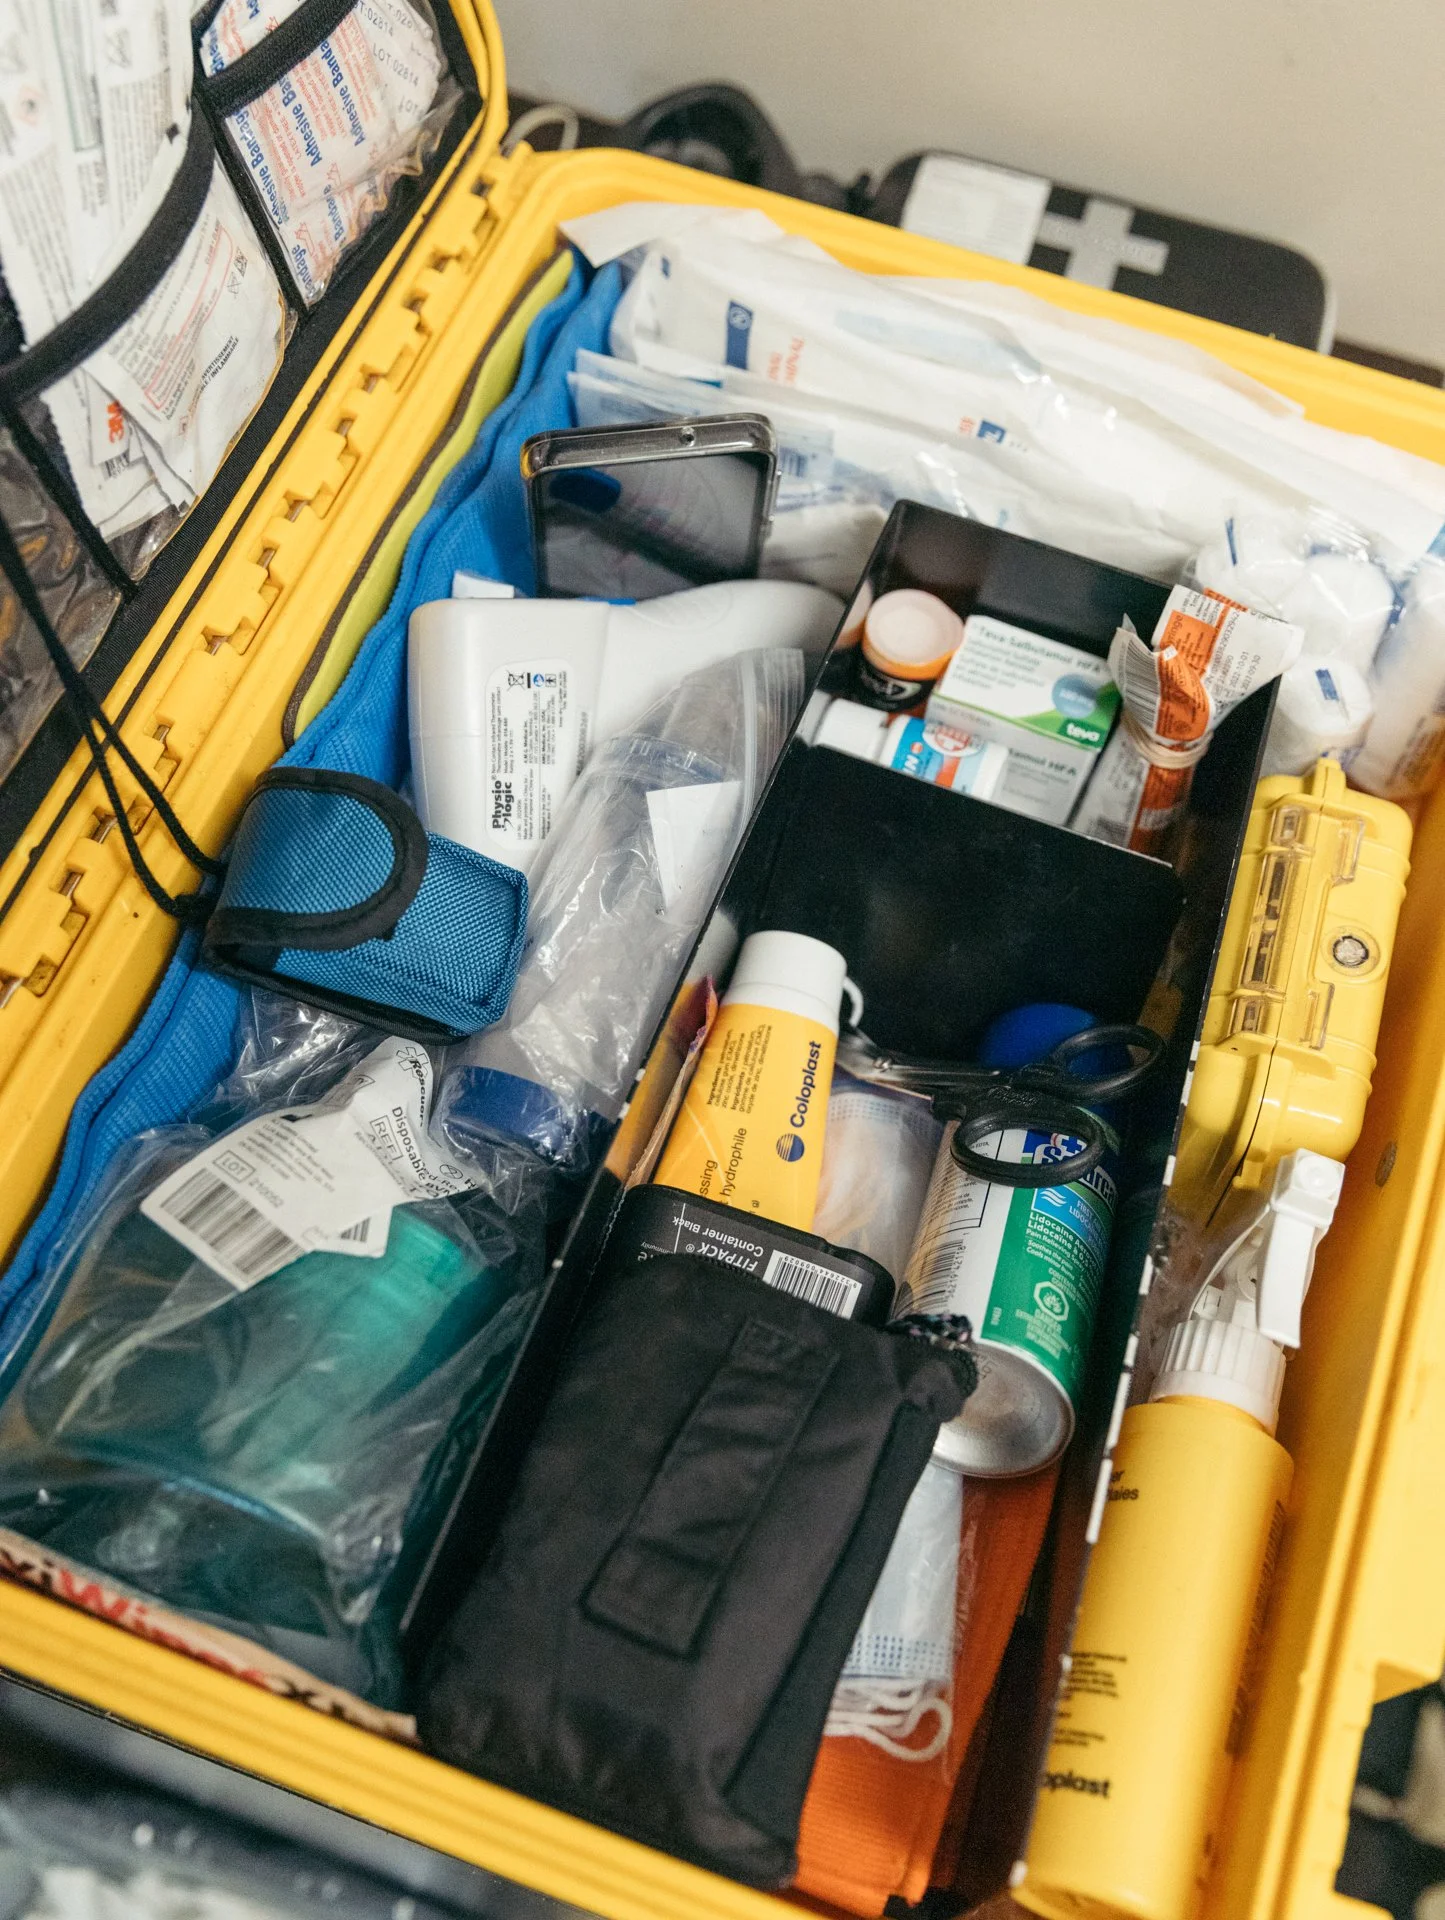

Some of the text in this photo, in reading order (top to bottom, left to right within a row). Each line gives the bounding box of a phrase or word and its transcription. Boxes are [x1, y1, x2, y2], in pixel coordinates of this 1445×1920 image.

[290, 102, 322, 167] Adhesive
[337, 84, 366, 147] Adhesive
[200, 334, 235, 380] AVERTISSEMENT
[1065, 721, 1101, 743] teva
[491, 779, 503, 829] Physio
[788, 1039, 821, 1129] Coloplast
[374, 1120, 397, 1155] REF
[390, 1105, 429, 1181] Disposable
[220, 1155, 246, 1178] LOT
[719, 1125, 750, 1198] hydrophile
[671, 1215, 764, 1258] Container Black
[1025, 1227, 1043, 1240] Pain
[1041, 1234, 1072, 1259] Relieving
[1027, 1219, 1072, 1250] Lidocaïne
[1029, 1211, 1074, 1242] Lidocaine
[695, 1240, 759, 1273] FITPACK
[1028, 1238, 1053, 1256] Soothes
